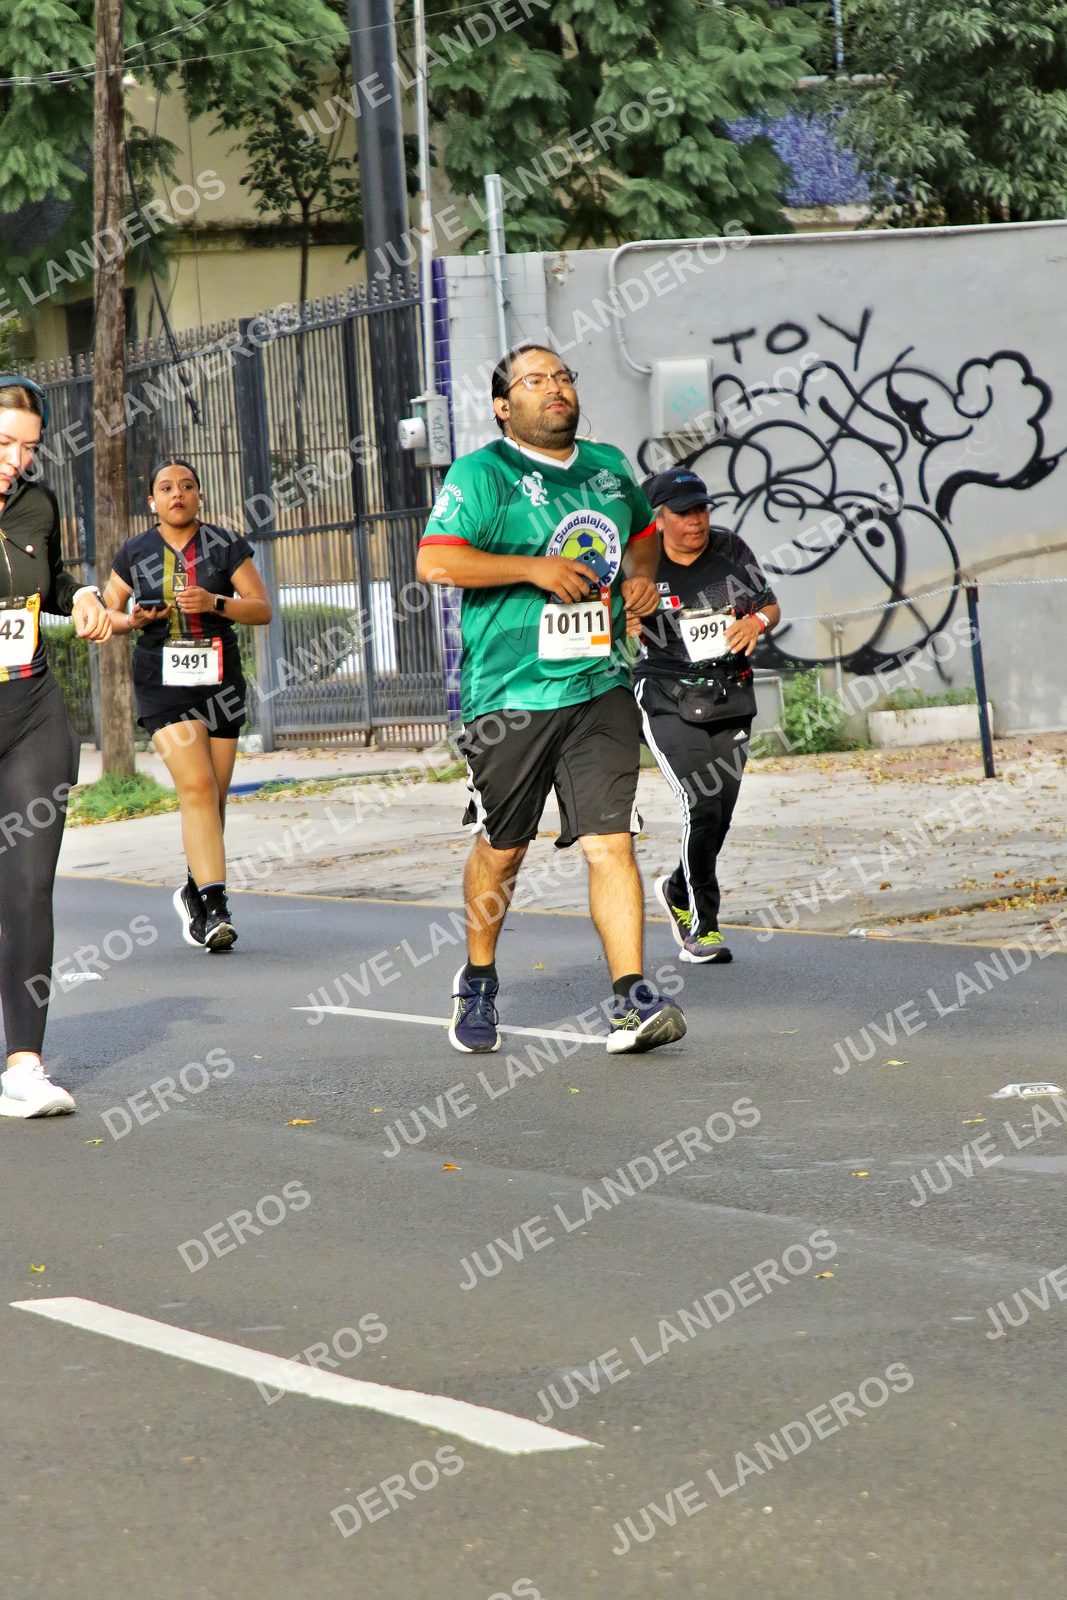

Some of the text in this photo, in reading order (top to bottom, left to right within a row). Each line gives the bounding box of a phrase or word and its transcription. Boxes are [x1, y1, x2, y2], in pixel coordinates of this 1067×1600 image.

[555, 515, 615, 544] Guadalajara
[544, 610, 605, 634] 10111
[689, 619, 727, 642] 9991
[171, 653, 208, 669] 9491
